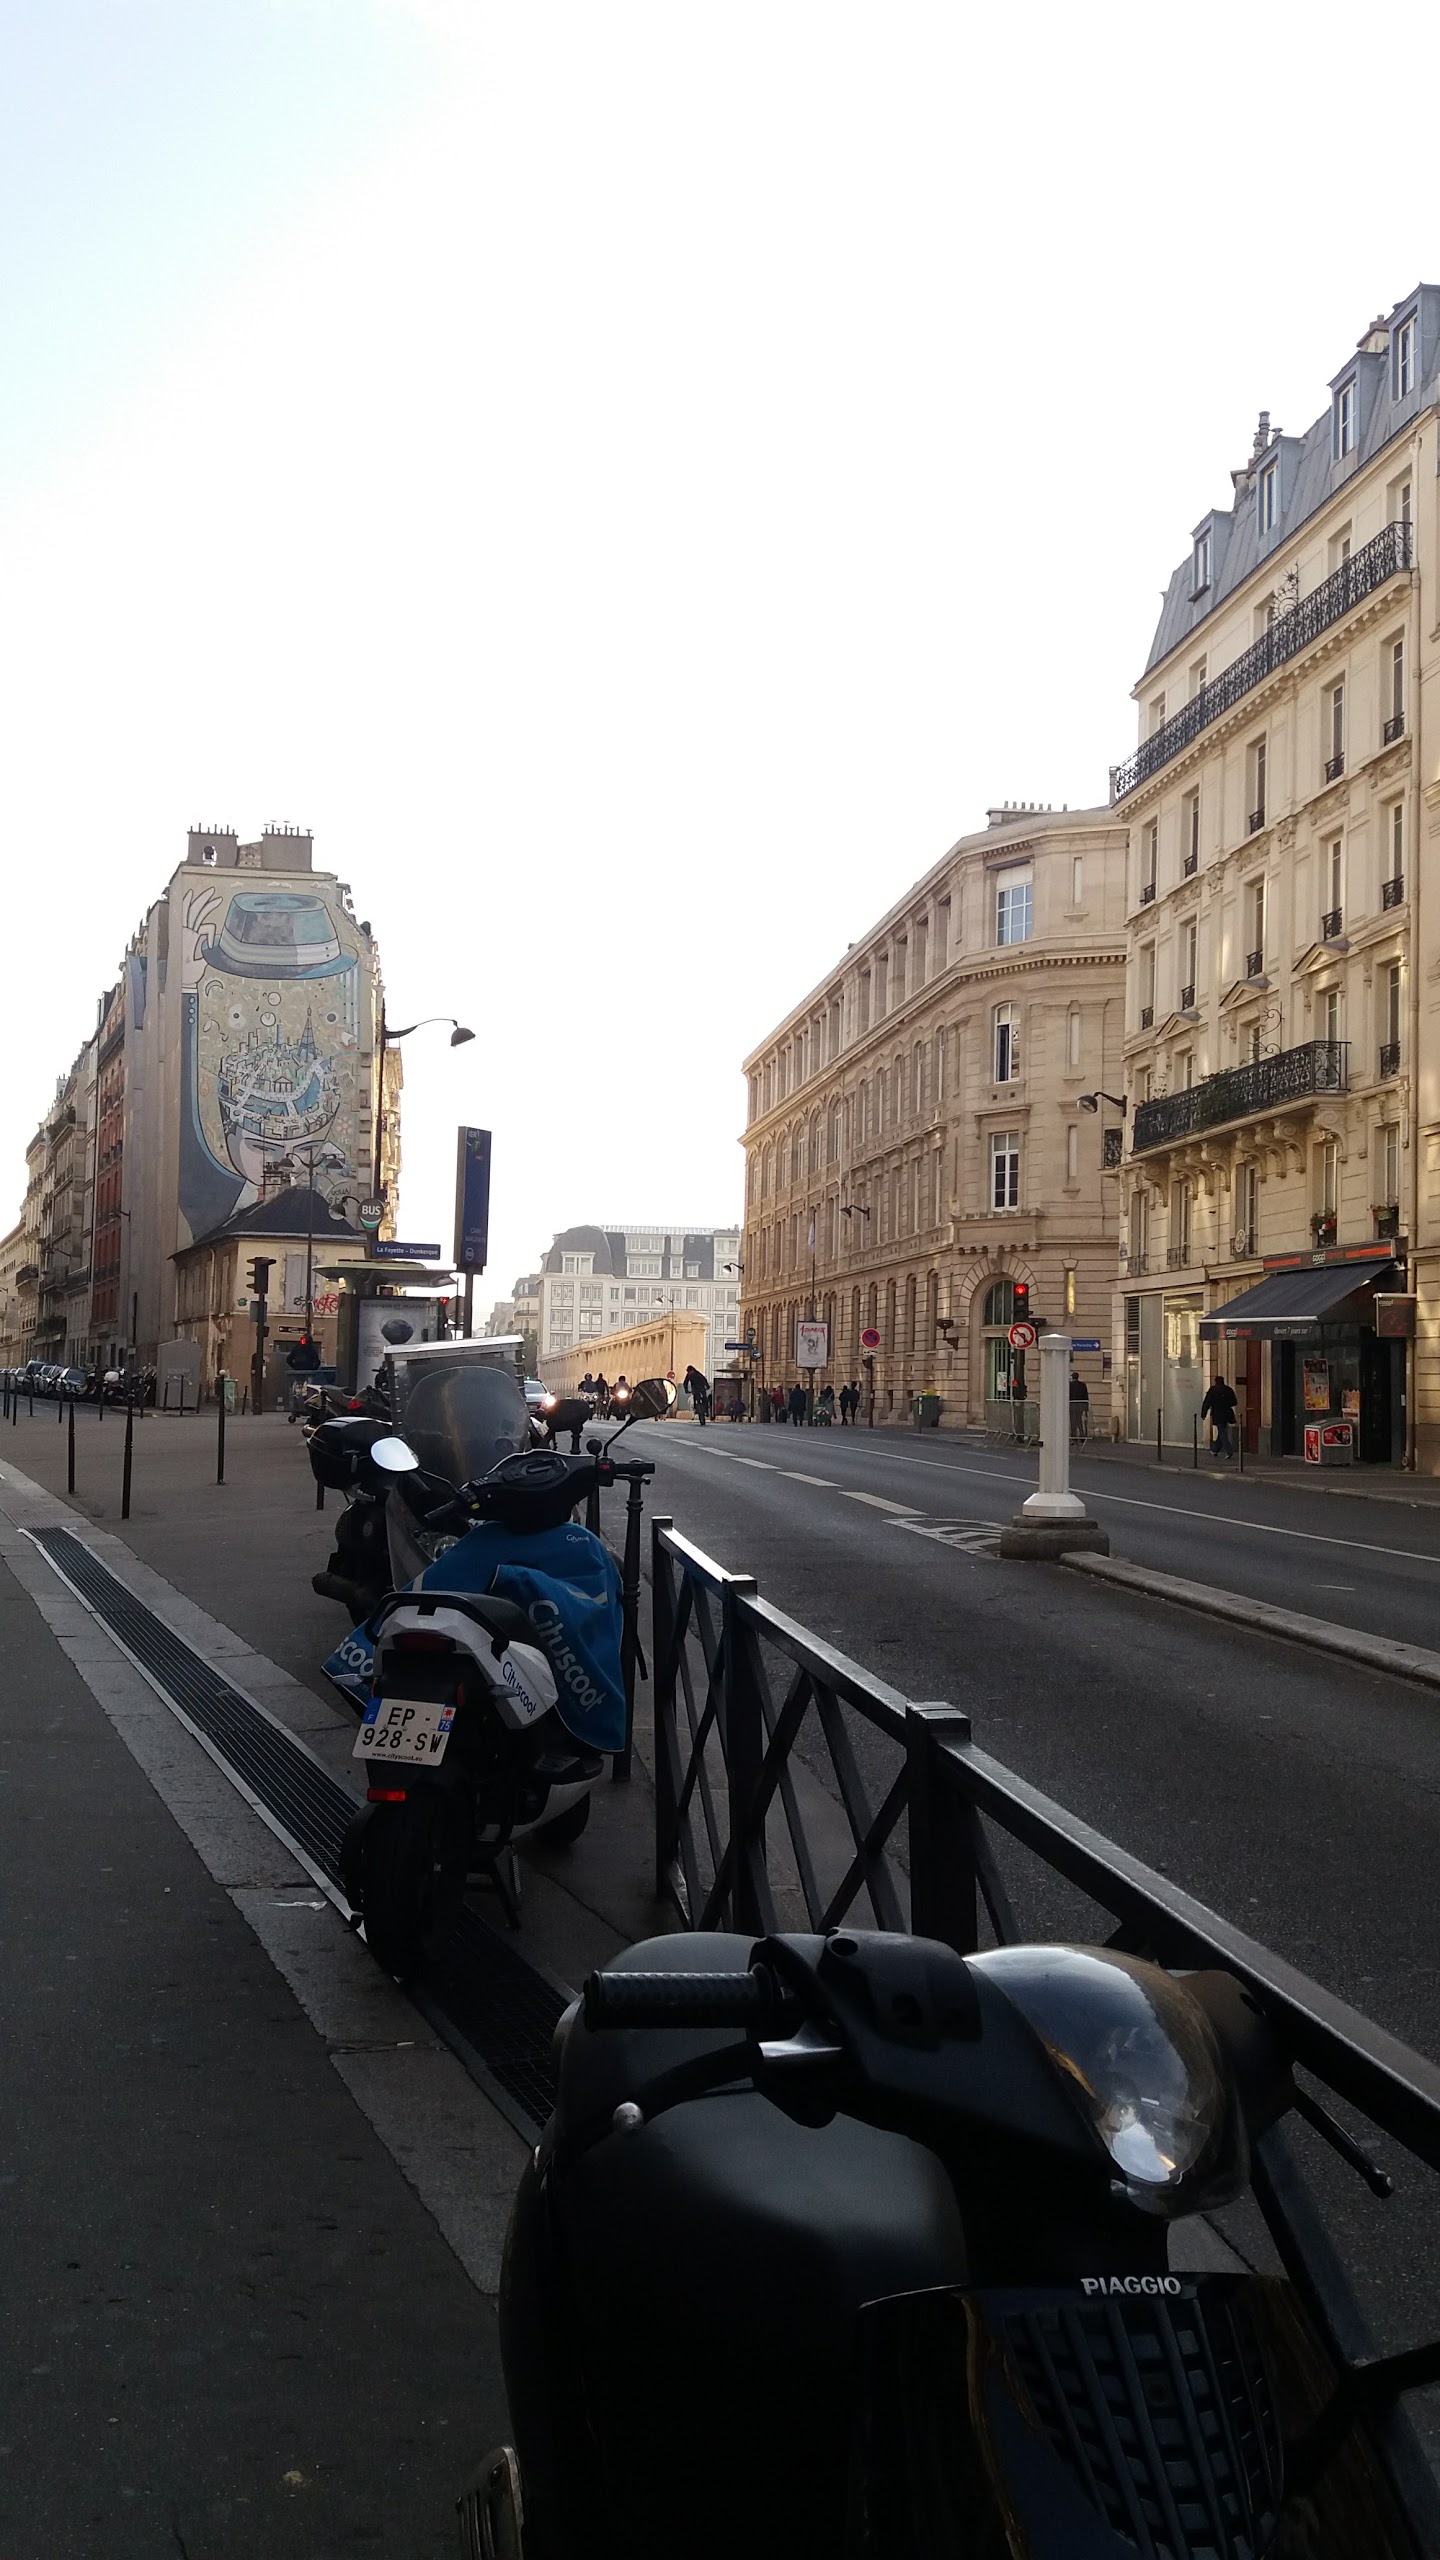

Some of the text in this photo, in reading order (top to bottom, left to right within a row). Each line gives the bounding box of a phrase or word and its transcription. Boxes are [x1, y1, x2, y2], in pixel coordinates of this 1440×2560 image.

[361, 1205, 381, 1215] BUS
[384, 1247, 404, 1255] Fayette
[409, 1248, 438, 1256] Dunkerque
[528, 1599, 607, 1712] Cityscoot
[503, 1660, 537, 1717] Cityscoot
[387, 1707, 416, 1726] EP
[441, 1720, 451, 1731] 75
[362, 1728, 443, 1753] 928-SW
[371, 1752, 423, 1762] www.cityscoot.eu
[1080, 2276, 1182, 2296] PIAGGIO
